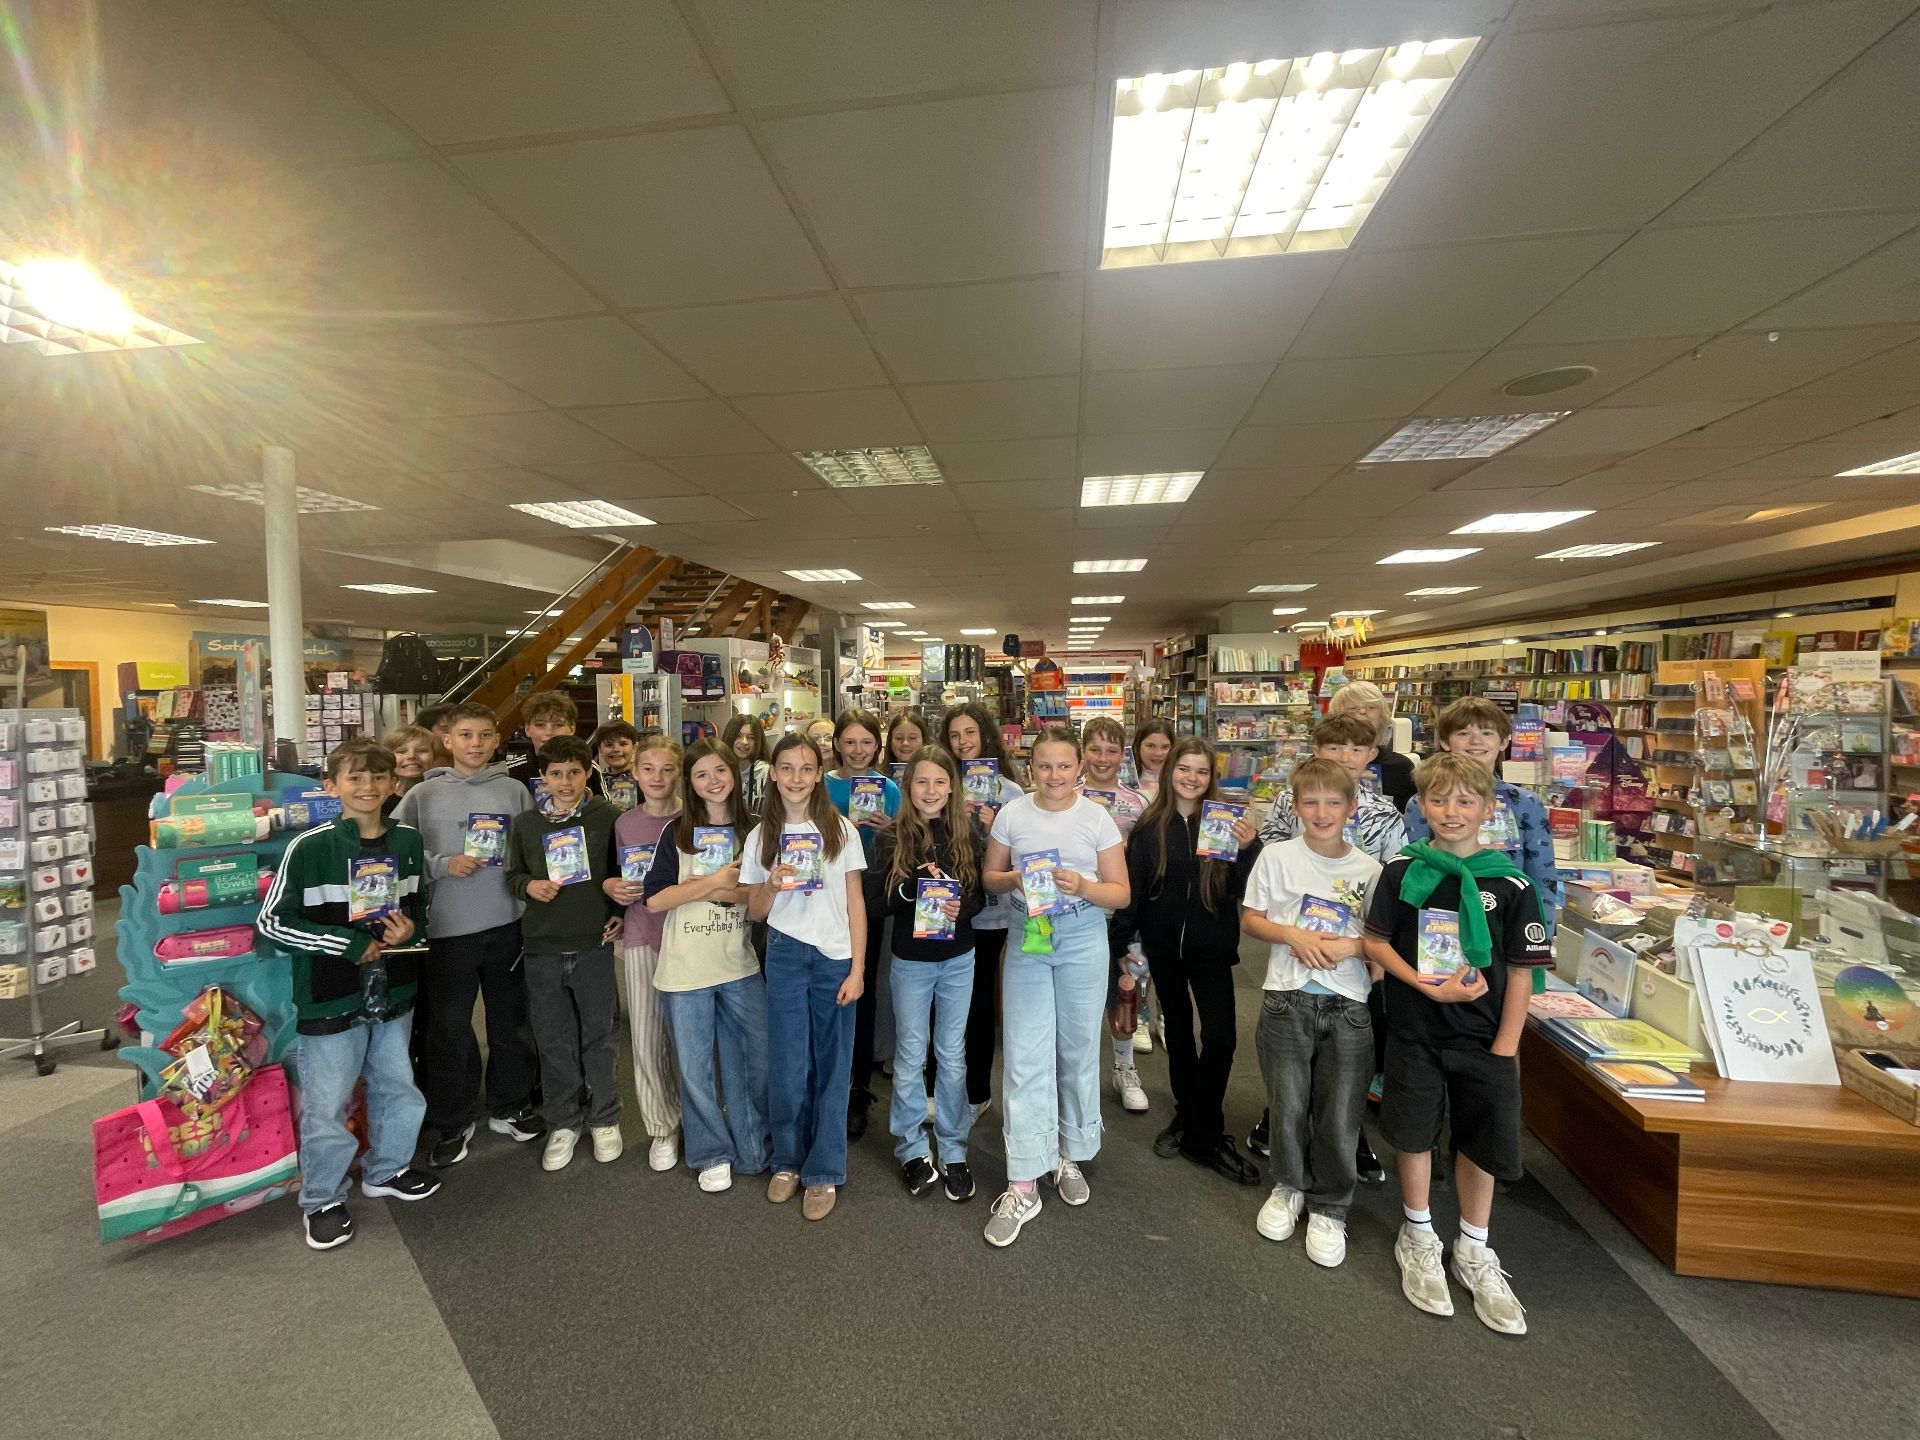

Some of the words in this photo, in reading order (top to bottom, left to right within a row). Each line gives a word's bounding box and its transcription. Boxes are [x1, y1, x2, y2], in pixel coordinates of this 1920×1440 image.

[303, 644, 338, 657] atch
[314, 801, 343, 809] BEAC
[315, 806, 344, 815] TOWE
[215, 873, 254, 883] BEACH
[215, 880, 254, 890] TOWEL
[708, 909, 720, 921] I'm
[683, 920, 733, 936] Everything
